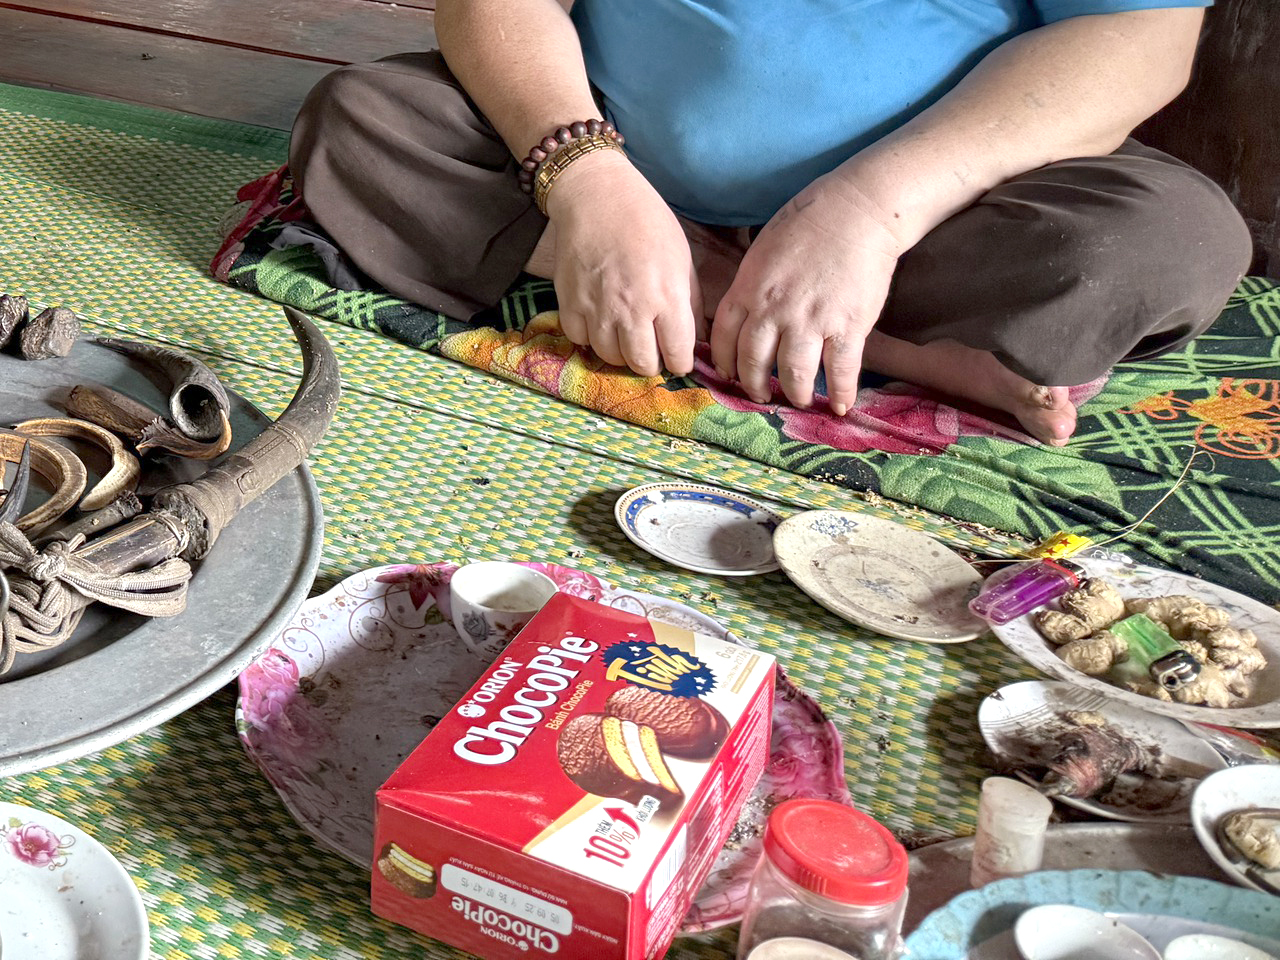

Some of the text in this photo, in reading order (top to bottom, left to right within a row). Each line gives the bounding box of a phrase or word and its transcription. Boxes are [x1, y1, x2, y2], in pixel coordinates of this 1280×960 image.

[715, 651, 731, 659] 6
[453, 637, 599, 765] ChocoPie
[473, 660, 523, 702] ORION
[545, 679, 594, 730] Bánh ChocoPie
[583, 829, 636, 868] 10%
[451, 896, 559, 953] ChocoPie
[480, 925, 516, 946] ORION
